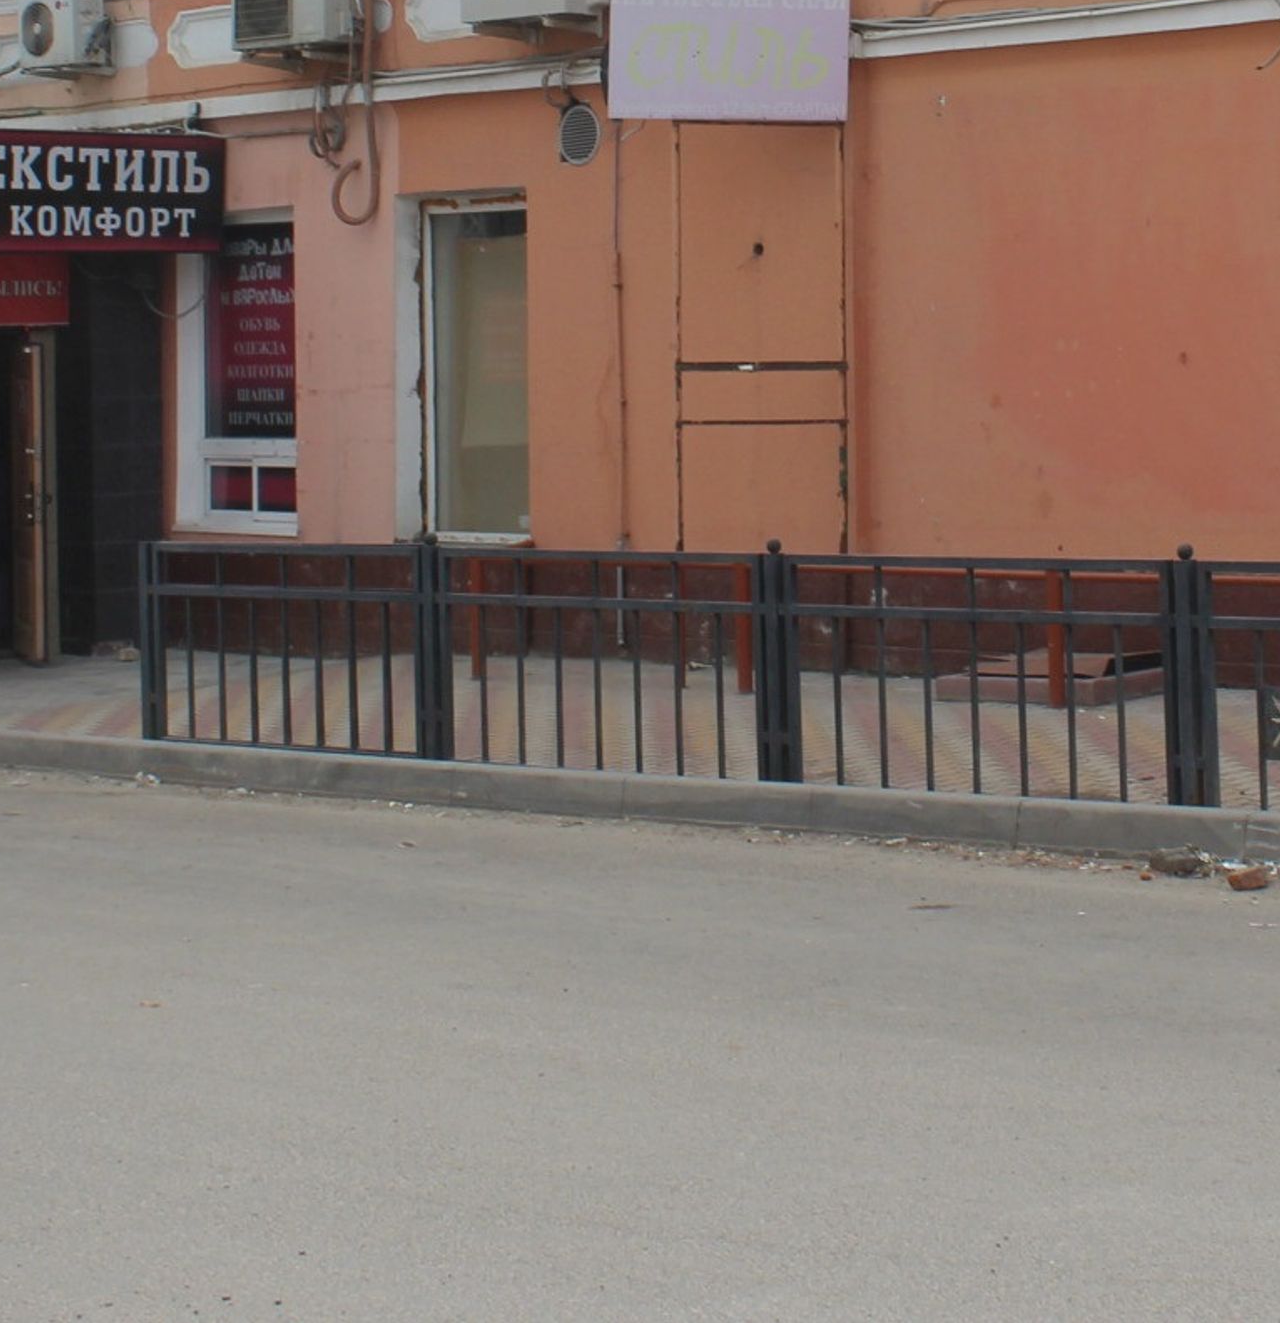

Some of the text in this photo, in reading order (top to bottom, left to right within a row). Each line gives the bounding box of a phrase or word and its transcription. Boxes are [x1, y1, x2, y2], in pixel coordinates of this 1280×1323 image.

[626, 20, 830, 91] СТИЛЬ
[10, 204, 197, 238] КОМФОРТ
[239, 317, 281, 332] ОБУВЬ
[233, 340, 287, 356] ОДЕЖДА
[227, 364, 294, 379] КОЛГОТКИ
[236, 387, 286, 402] ШАПКИ
[228, 411, 294, 426] ПЕРЧАТКИ
